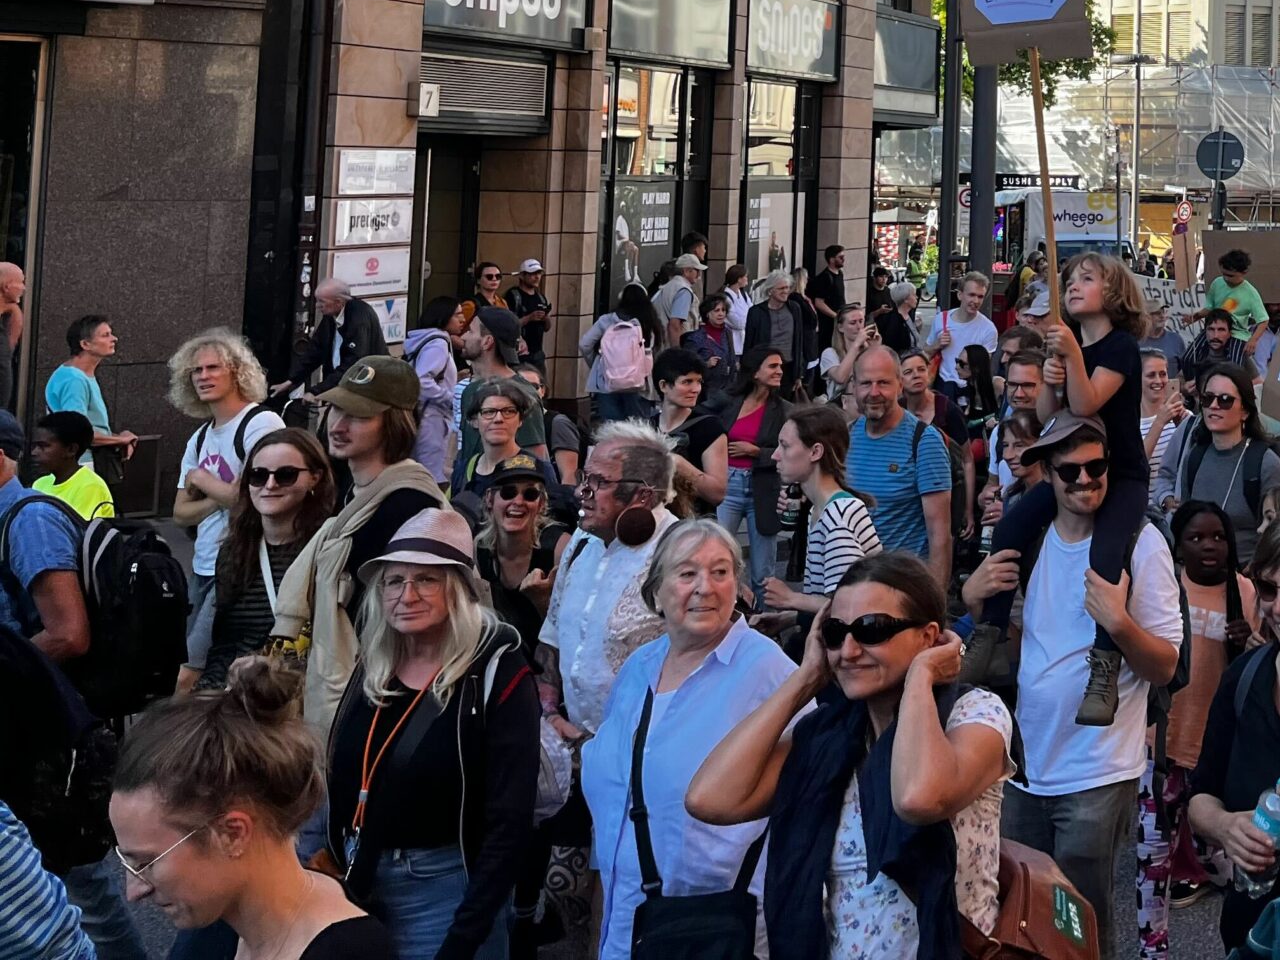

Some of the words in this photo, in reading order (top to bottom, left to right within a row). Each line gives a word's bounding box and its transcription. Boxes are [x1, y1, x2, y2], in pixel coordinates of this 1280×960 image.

[425, 90, 433, 109] 7
[1002, 176, 1031, 186] SUSHI
[1035, 177, 1074, 186] SPPLY
[1053, 209, 1104, 225] wheego
[1180, 206, 1189, 217] 25
